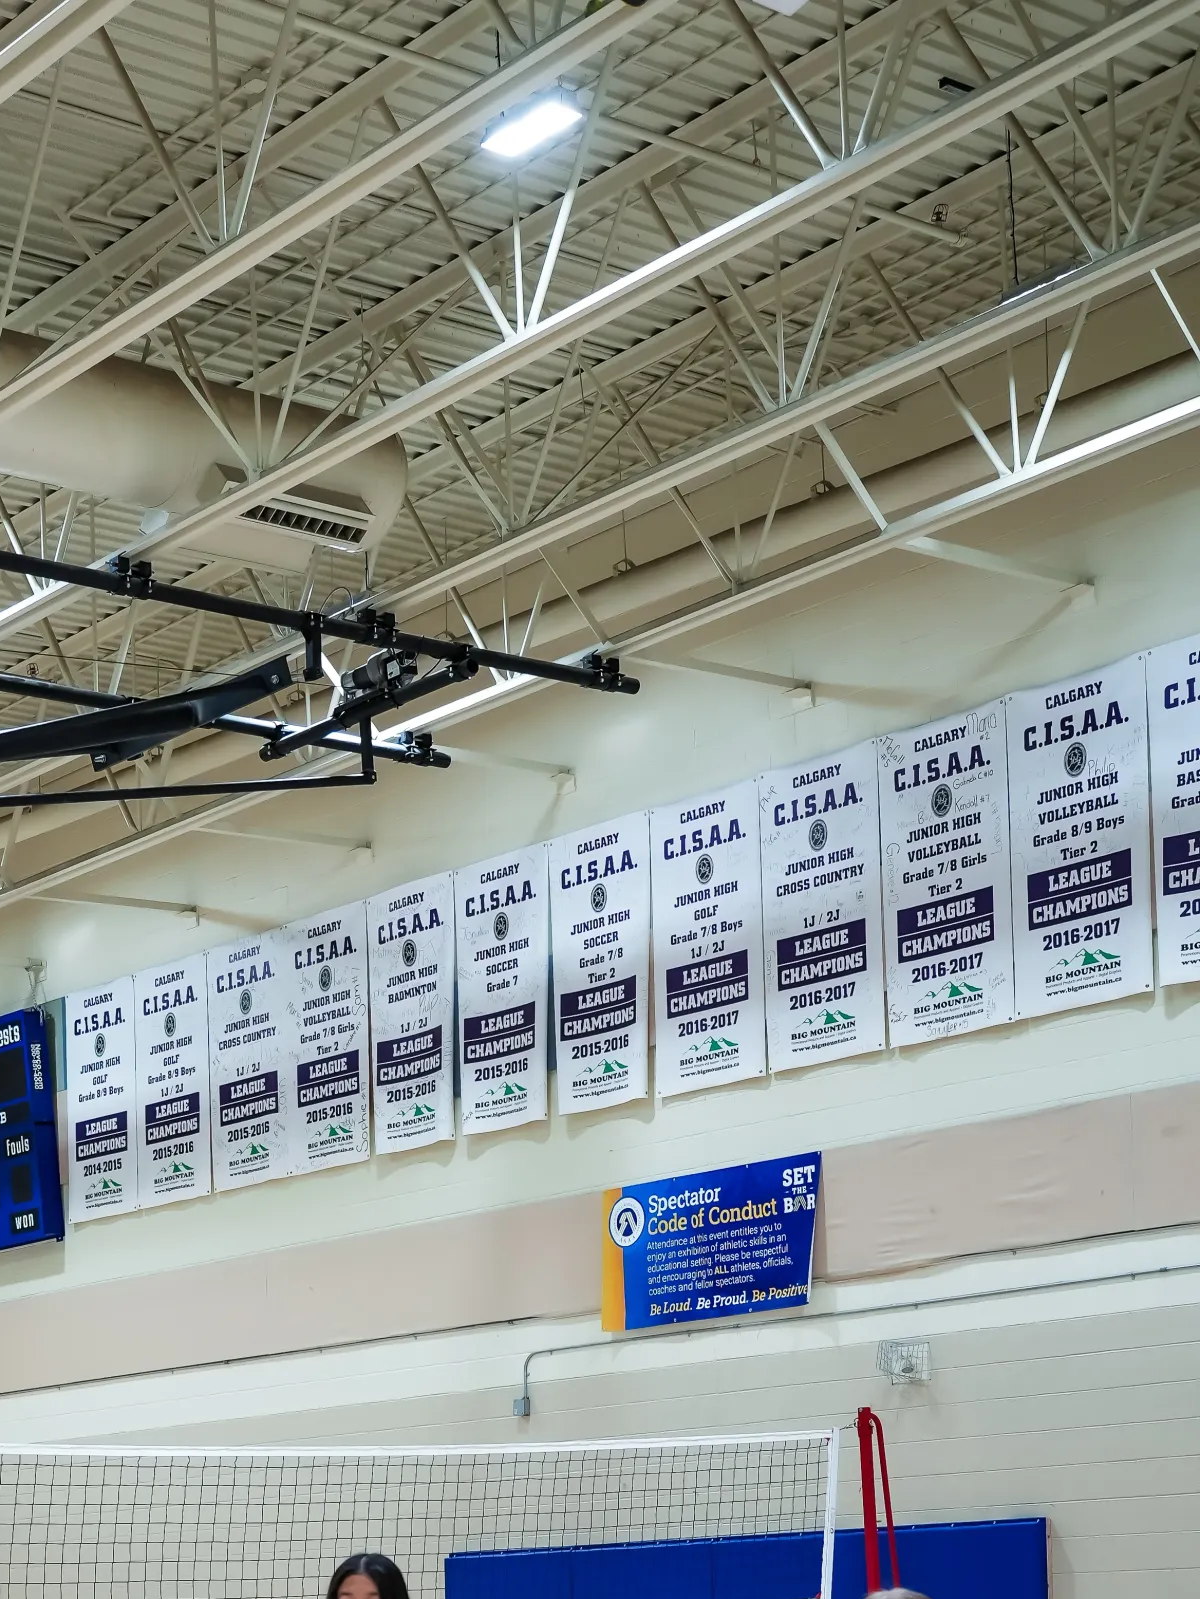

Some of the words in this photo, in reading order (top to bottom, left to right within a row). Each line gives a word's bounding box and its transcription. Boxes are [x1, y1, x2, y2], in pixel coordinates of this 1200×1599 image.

[914, 726, 966, 752] CALGARY
[1024, 701, 1129, 752] C.I.S.A.A.
[894, 745, 990, 791] C.I.S.A.A.
[680, 801, 725, 824] CALGARY
[774, 782, 863, 827] C.I.S.A.A.
[664, 819, 746, 861] C.I.S.A.A.
[907, 820, 947, 844] JUNIOR
[952, 812, 981, 834] HIGH
[1033, 828, 1067, 848] Grade
[1071, 822, 1093, 841] 8/9
[1096, 814, 1125, 834] Boys
[908, 834, 982, 863] VOLLEYBALL
[776, 879, 810, 898] CROSS
[813, 864, 864, 888] COUNTRY
[903, 866, 933, 885] Grade
[937, 861, 959, 881] 7/8
[961, 852, 987, 871] Girls
[466, 881, 536, 917] C.I.S.A.A.
[928, 882, 951, 898] Tier
[955, 878, 963, 892] 2
[694, 905, 718, 921] GOLF
[916, 898, 976, 926] LEAGUE
[1032, 886, 1128, 924] CHAMPIONS
[584, 931, 618, 950] SOCCER
[902, 921, 990, 956] CHAMPIONS
[1043, 919, 1121, 951] 2016-2017
[216, 961, 275, 993] C.I.S.A.A.
[911, 954, 983, 983] 2016-2017
[143, 987, 197, 1016] C.I.S.A.A.
[388, 981, 437, 1004] BADMINTON
[577, 985, 625, 1010] LEAGUE
[790, 983, 856, 1010] 2016-2017
[914, 1004, 932, 1014] BIG
[933, 992, 983, 1011] MOUNTAIN
[74, 1008, 126, 1036] C.I.S.A.A.
[303, 1006, 351, 1027] VOLLEYBALL
[564, 1006, 634, 1036] CHAMPIONS
[678, 1010, 739, 1037] 2016-2017
[915, 1008, 984, 1027] www.bigmountain.ca
[379, 1053, 441, 1082] CHAMPIONS
[475, 1058, 528, 1082] 2015-2016
[306, 1103, 353, 1124] 2015-2016
[6, 1136, 30, 1156] fouls
[152, 1143, 194, 1161] 2015-2016
[83, 1159, 122, 1177] 2014-2015
[782, 1165, 815, 1186] SET
[649, 1187, 721, 1213] Spectator
[15, 1213, 34, 1230] won
[648, 1217, 686, 1235] Code
[691, 1211, 704, 1226] of
[709, 1199, 777, 1225] Conduct
[647, 1237, 688, 1250] Attendance
[690, 1236, 696, 1244] at
[697, 1233, 707, 1242] this
[709, 1230, 728, 1241] event
[730, 1225, 758, 1238] entitles
[760, 1224, 773, 1236] you
[774, 1222, 781, 1230] to
[647, 1251, 666, 1262] enjoy
[668, 1250, 676, 1258] an
[677, 1245, 709, 1258] exhibition
[710, 1243, 718, 1252] of
[720, 1238, 747, 1251] athletic
[749, 1235, 767, 1247] skills
[777, 1234, 786, 1242] an
[647, 1259, 688, 1273] educational
[715, 1250, 739, 1262] Please
[741, 1249, 750, 1258] be
[752, 1244, 788, 1258] respectful
[648, 1274, 660, 1284] and
[662, 1269, 706, 1284] encouraging
[714, 1265, 729, 1274] ALL
[731, 1261, 762, 1273] athletes,
[763, 1256, 793, 1268] officials,
[649, 1286, 676, 1296] coaches
[678, 1281, 693, 1291] and
[695, 1279, 714, 1289] fellow
[716, 1274, 755, 1288] spectators.
[650, 1303, 661, 1316] Be
[663, 1299, 692, 1314] Loud.
[696, 1297, 710, 1310] Be
[712, 1292, 748, 1308] Proud.
[752, 1290, 765, 1302] Be
